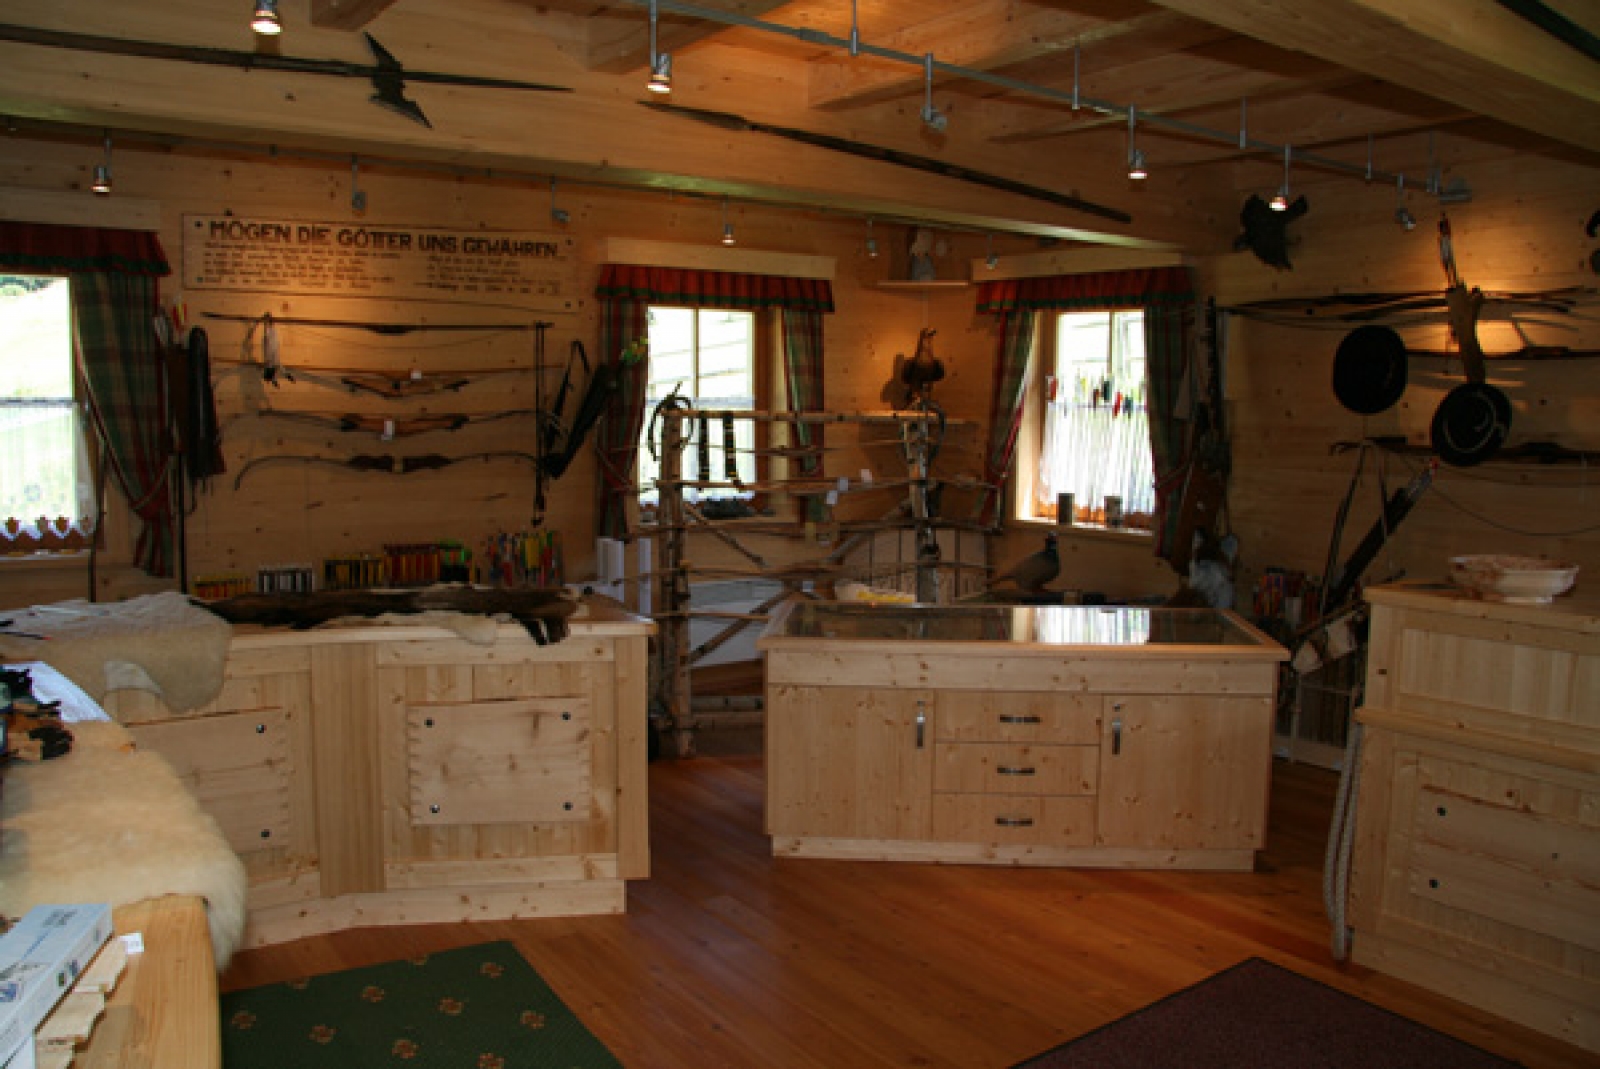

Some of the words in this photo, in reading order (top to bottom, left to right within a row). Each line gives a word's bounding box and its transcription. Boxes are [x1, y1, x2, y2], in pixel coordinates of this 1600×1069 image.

[210, 220, 291, 243] MÖGEN
[298, 224, 331, 244] DIE
[337, 227, 411, 251] GÖTTER
[418, 234, 457, 253] UNS
[462, 236, 558, 256] GEWÄHREN
